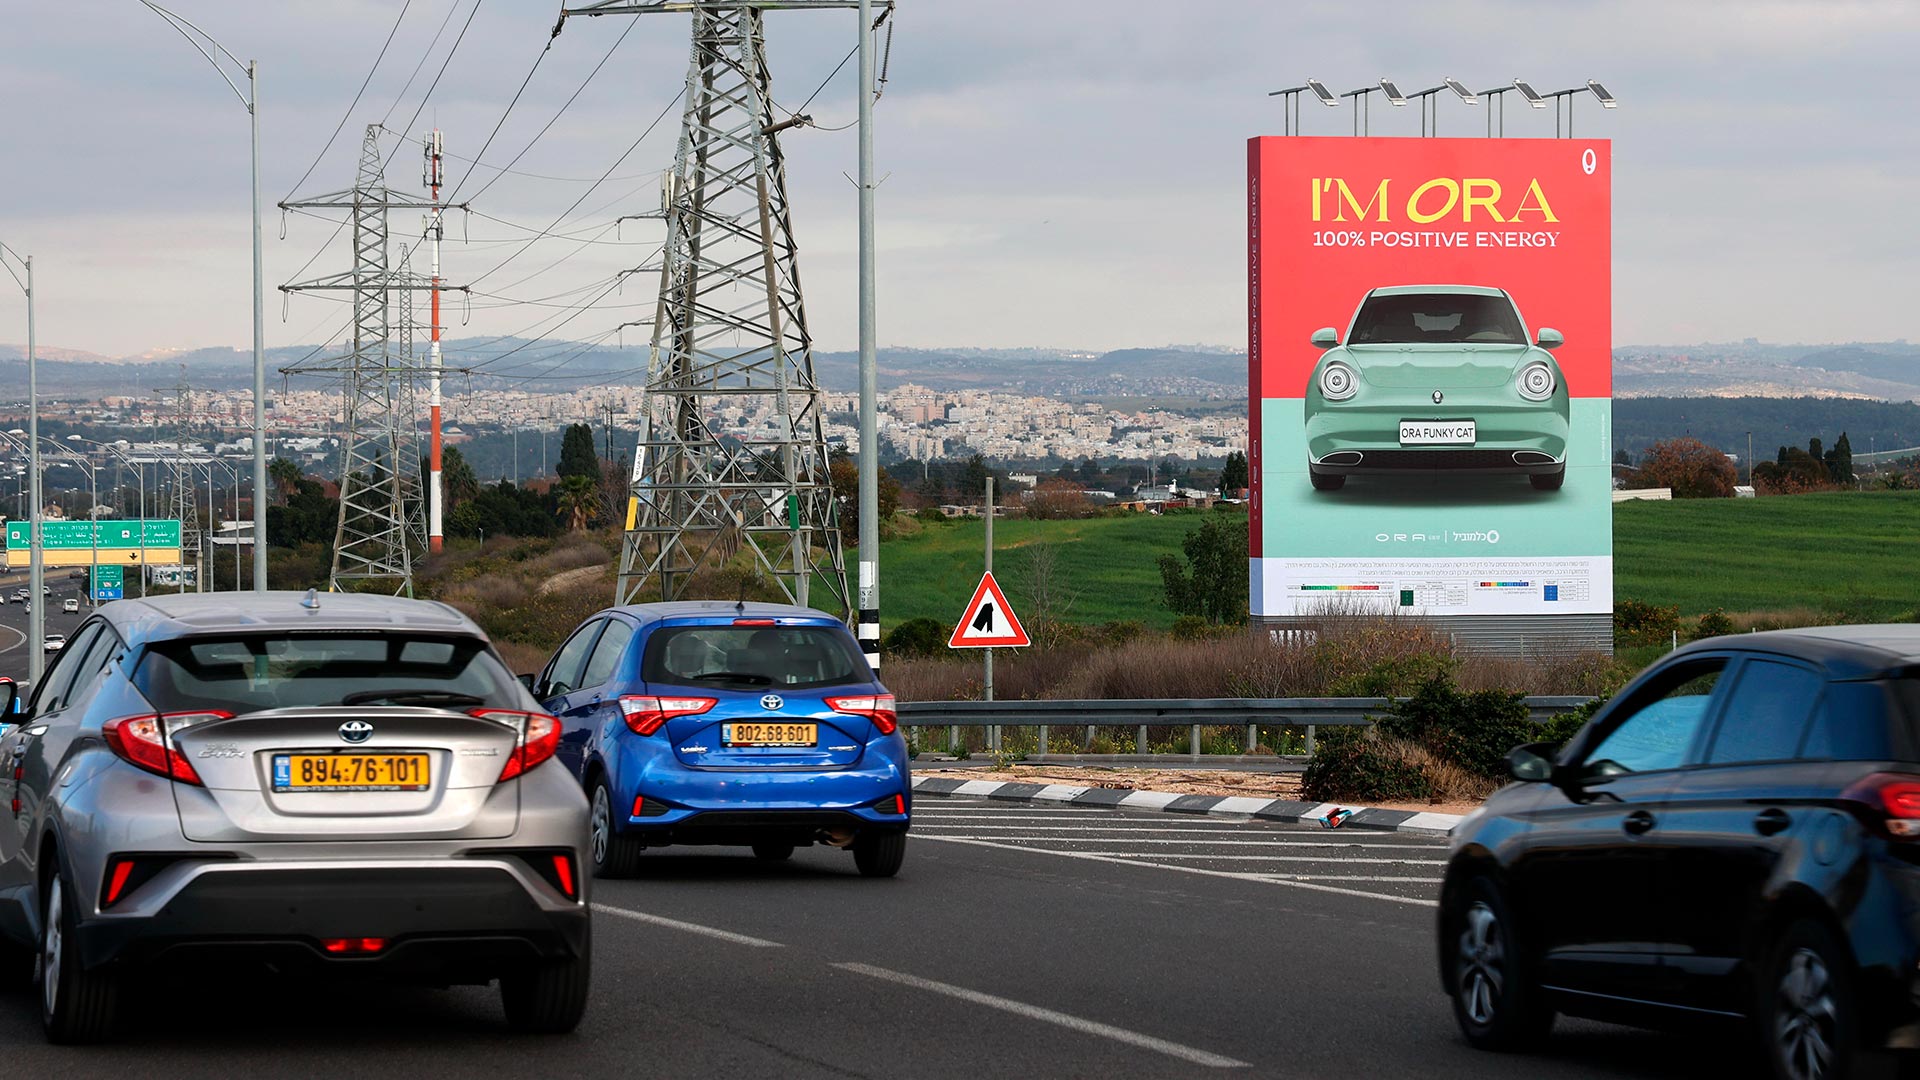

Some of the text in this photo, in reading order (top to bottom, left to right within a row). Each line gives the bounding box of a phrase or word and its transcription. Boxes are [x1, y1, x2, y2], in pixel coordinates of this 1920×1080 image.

[1312, 177, 1560, 223] I'M ORA
[1313, 231, 1560, 247] 100% POSITIVE ENERGY
[1401, 427, 1474, 438] ORA FUNKY CAT
[1375, 533, 1426, 542] ORA
